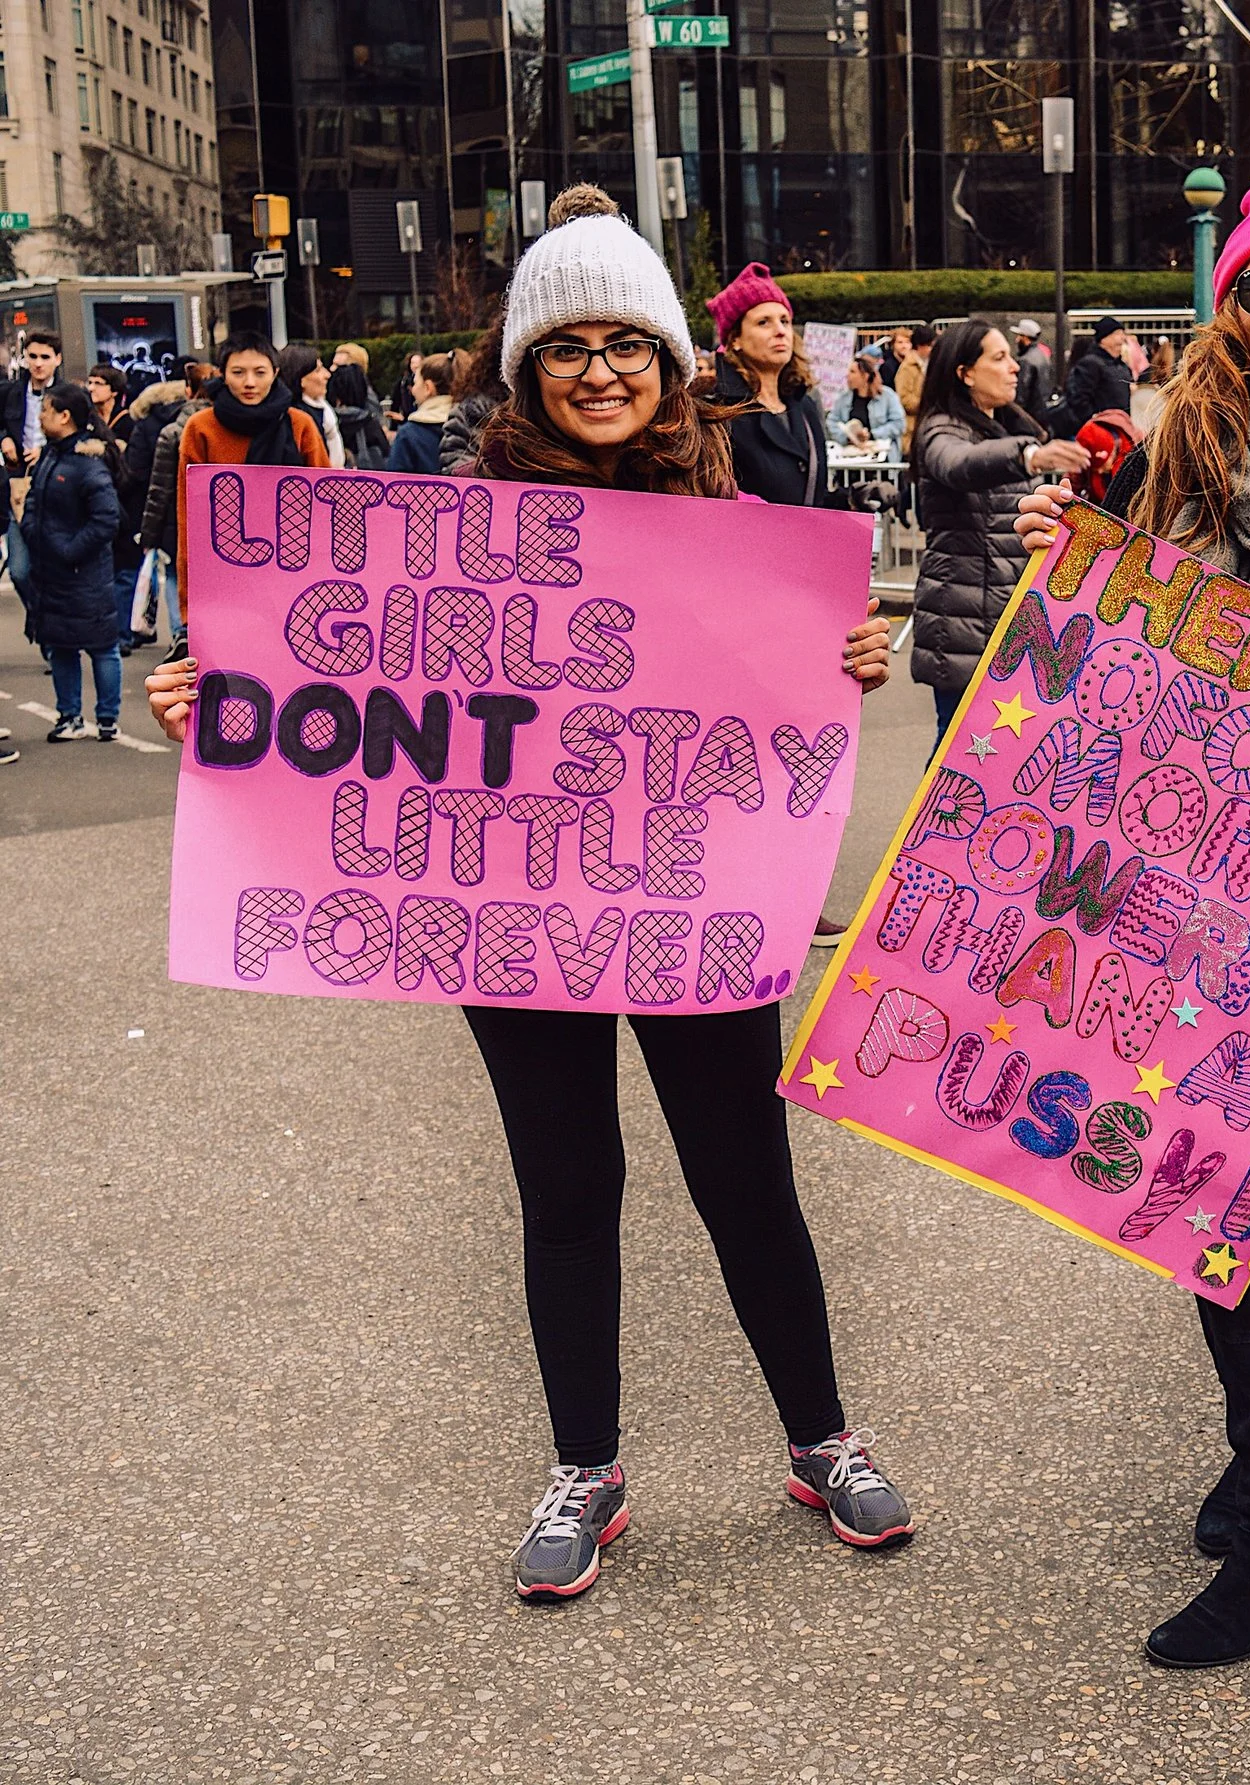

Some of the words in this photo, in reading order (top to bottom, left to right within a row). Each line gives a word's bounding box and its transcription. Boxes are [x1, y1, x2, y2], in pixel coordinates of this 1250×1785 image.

[658, 20, 673, 43] W
[680, 20, 702, 43] 60
[1, 214, 13, 228] 60
[209, 471, 585, 588] LITTLE
[284, 580, 636, 692] GIRLS
[988, 590, 1160, 732] NO
[194, 670, 540, 789] DON'T
[553, 702, 850, 819] STAY
[332, 780, 710, 901] LITTLE
[876, 853, 1174, 1062] THAN
